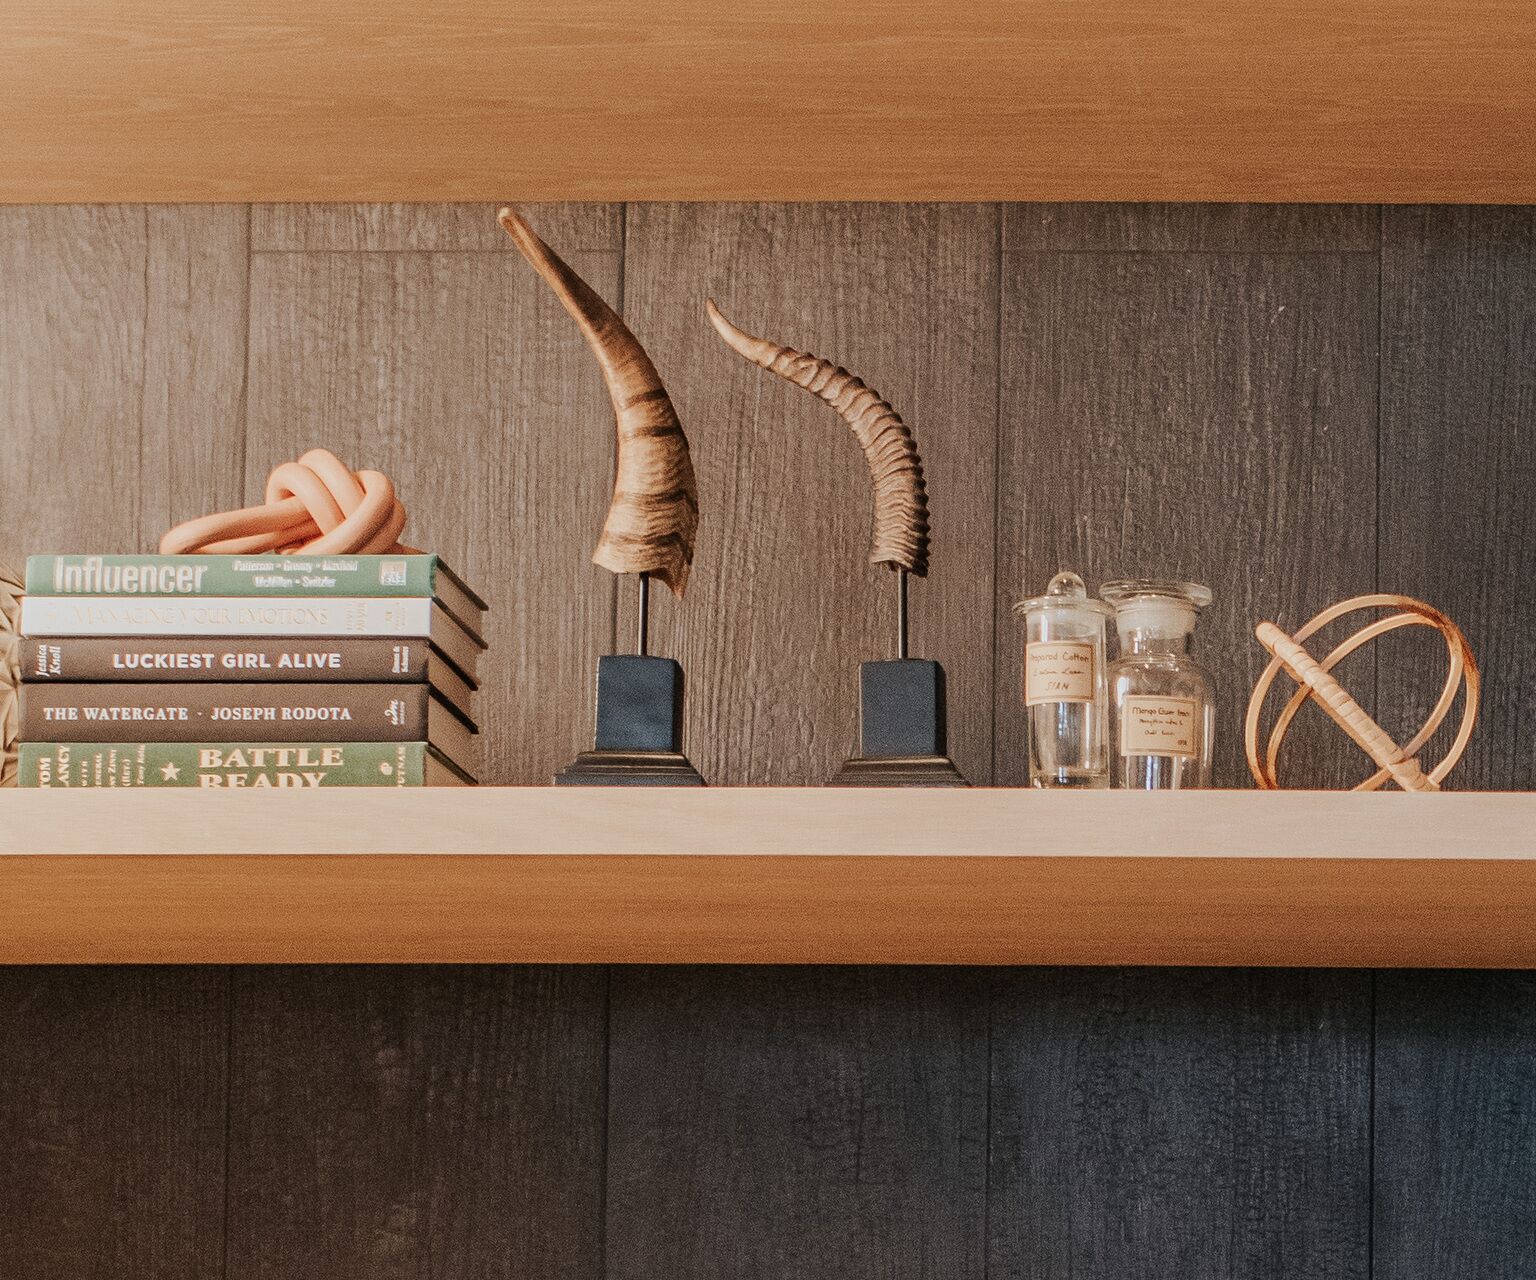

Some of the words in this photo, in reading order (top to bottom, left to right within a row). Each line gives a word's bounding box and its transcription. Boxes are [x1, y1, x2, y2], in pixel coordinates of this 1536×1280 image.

[53, 557, 208, 593] Influencer
[237, 607, 329, 626] EMOTIONS
[36, 644, 49, 677] Jessica
[49, 645, 61, 675] Knoll
[112, 653, 215, 669] LUCKIEST
[222, 653, 271, 669] GIRL
[278, 653, 342, 669] ALIVE
[43, 707, 78, 721] THE
[83, 707, 189, 721] WATERGATE
[210, 707, 276, 721] JOSEPH
[281, 707, 353, 721] RODOTA
[198, 747, 344, 768] BATTLE
[198, 772, 327, 788] READY
